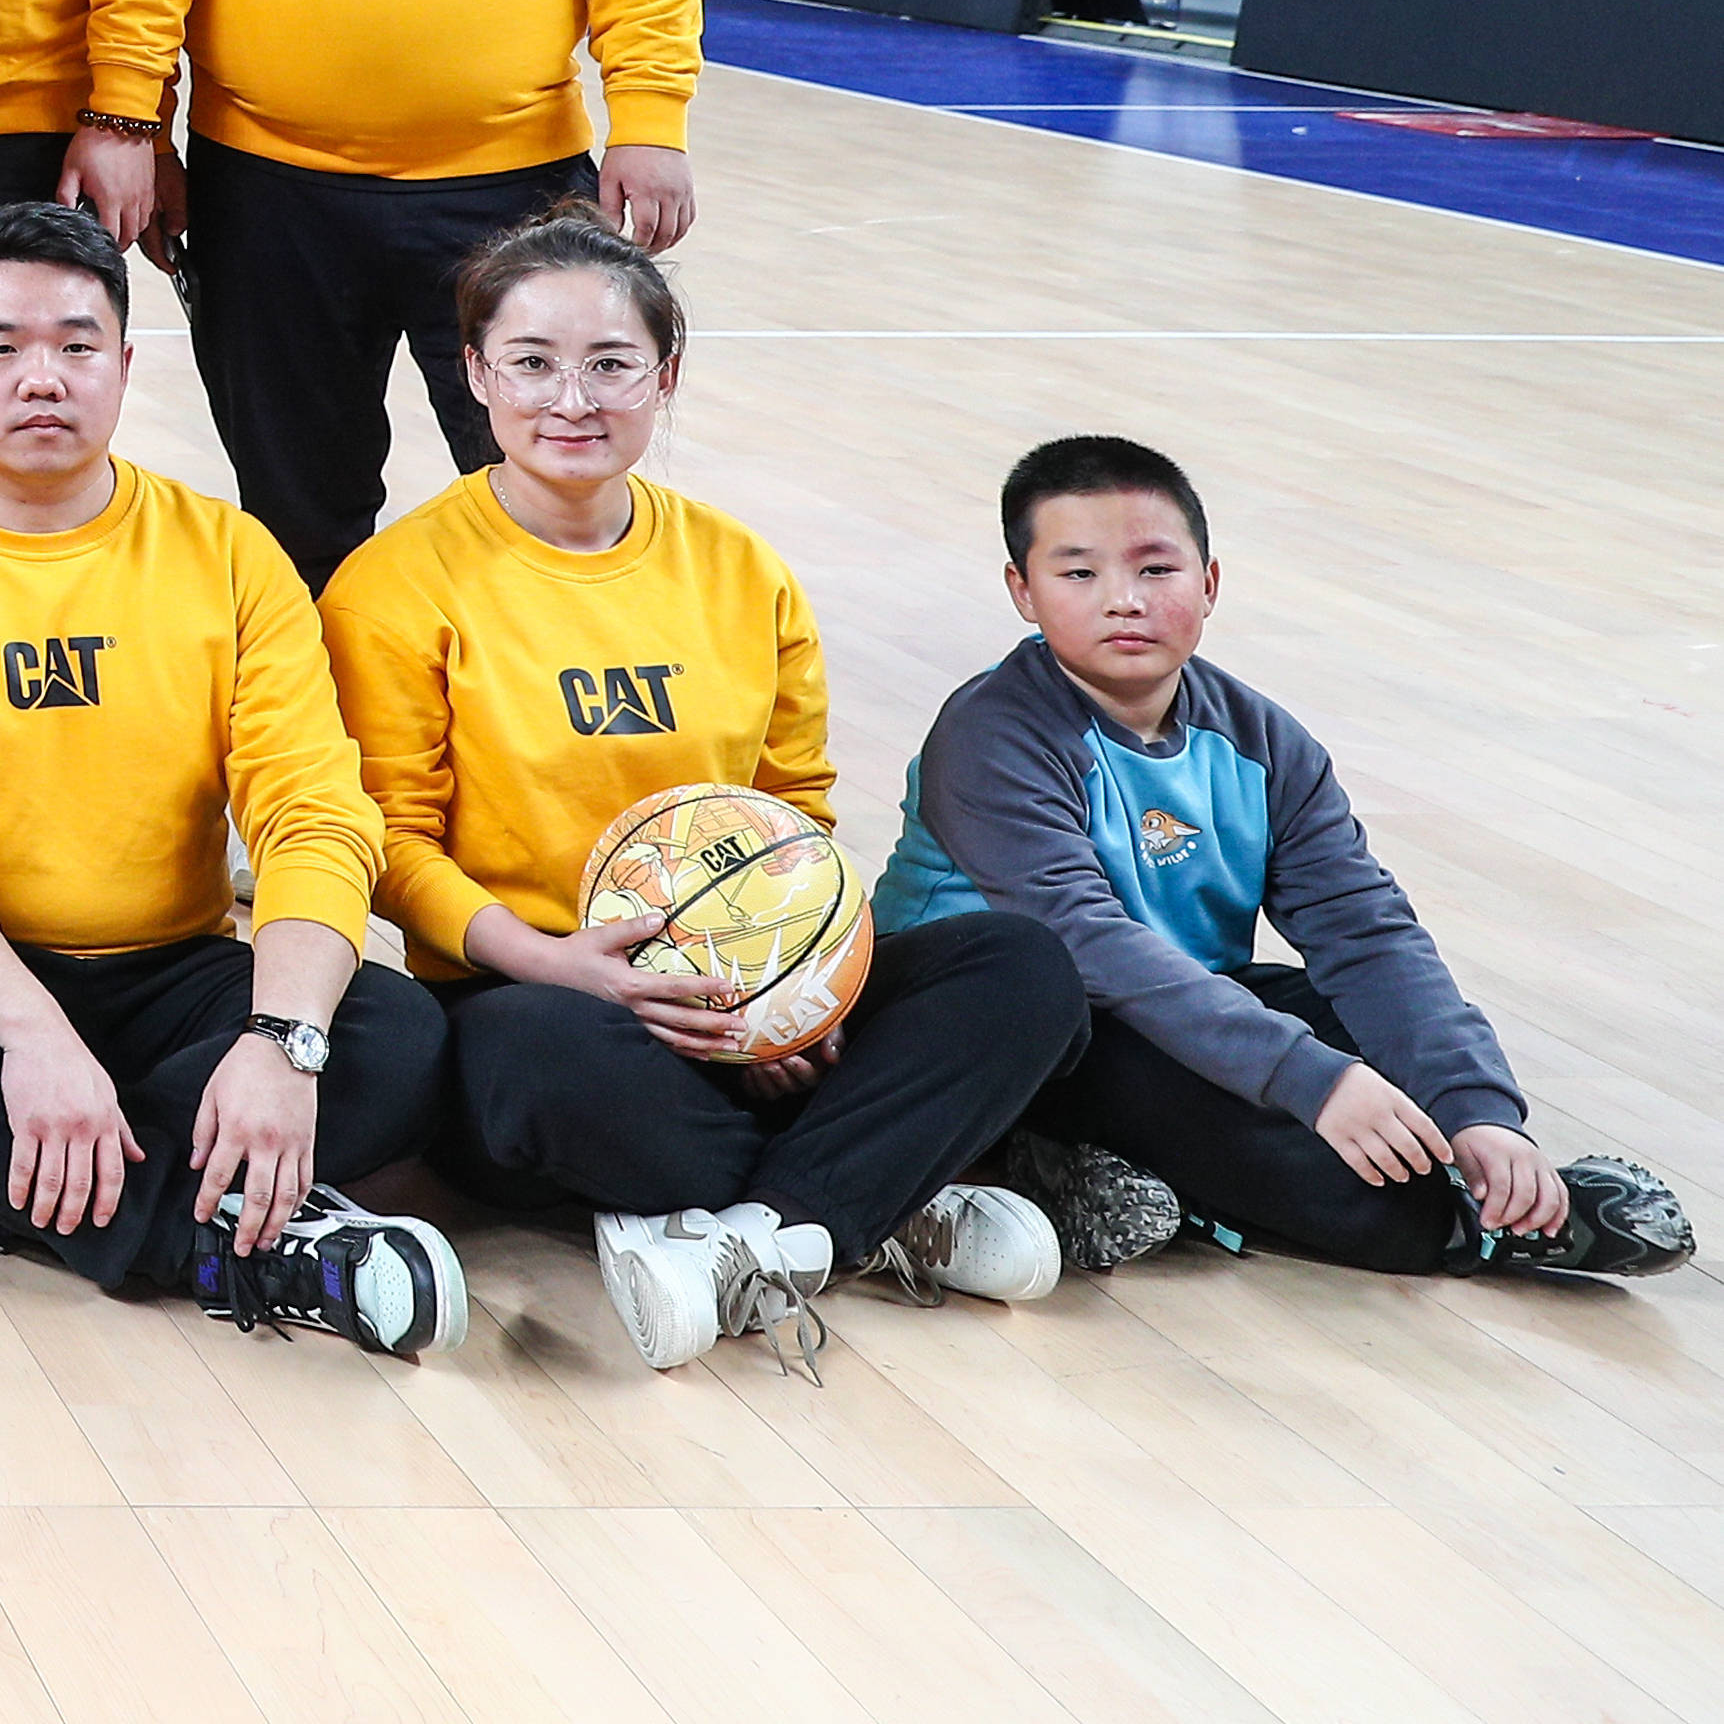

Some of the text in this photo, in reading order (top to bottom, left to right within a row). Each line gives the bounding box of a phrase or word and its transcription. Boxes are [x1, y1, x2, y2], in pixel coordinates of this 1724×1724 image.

[4, 636, 116, 710] CAT
[559, 664, 684, 736] CAT
[701, 836, 748, 872] CAT
